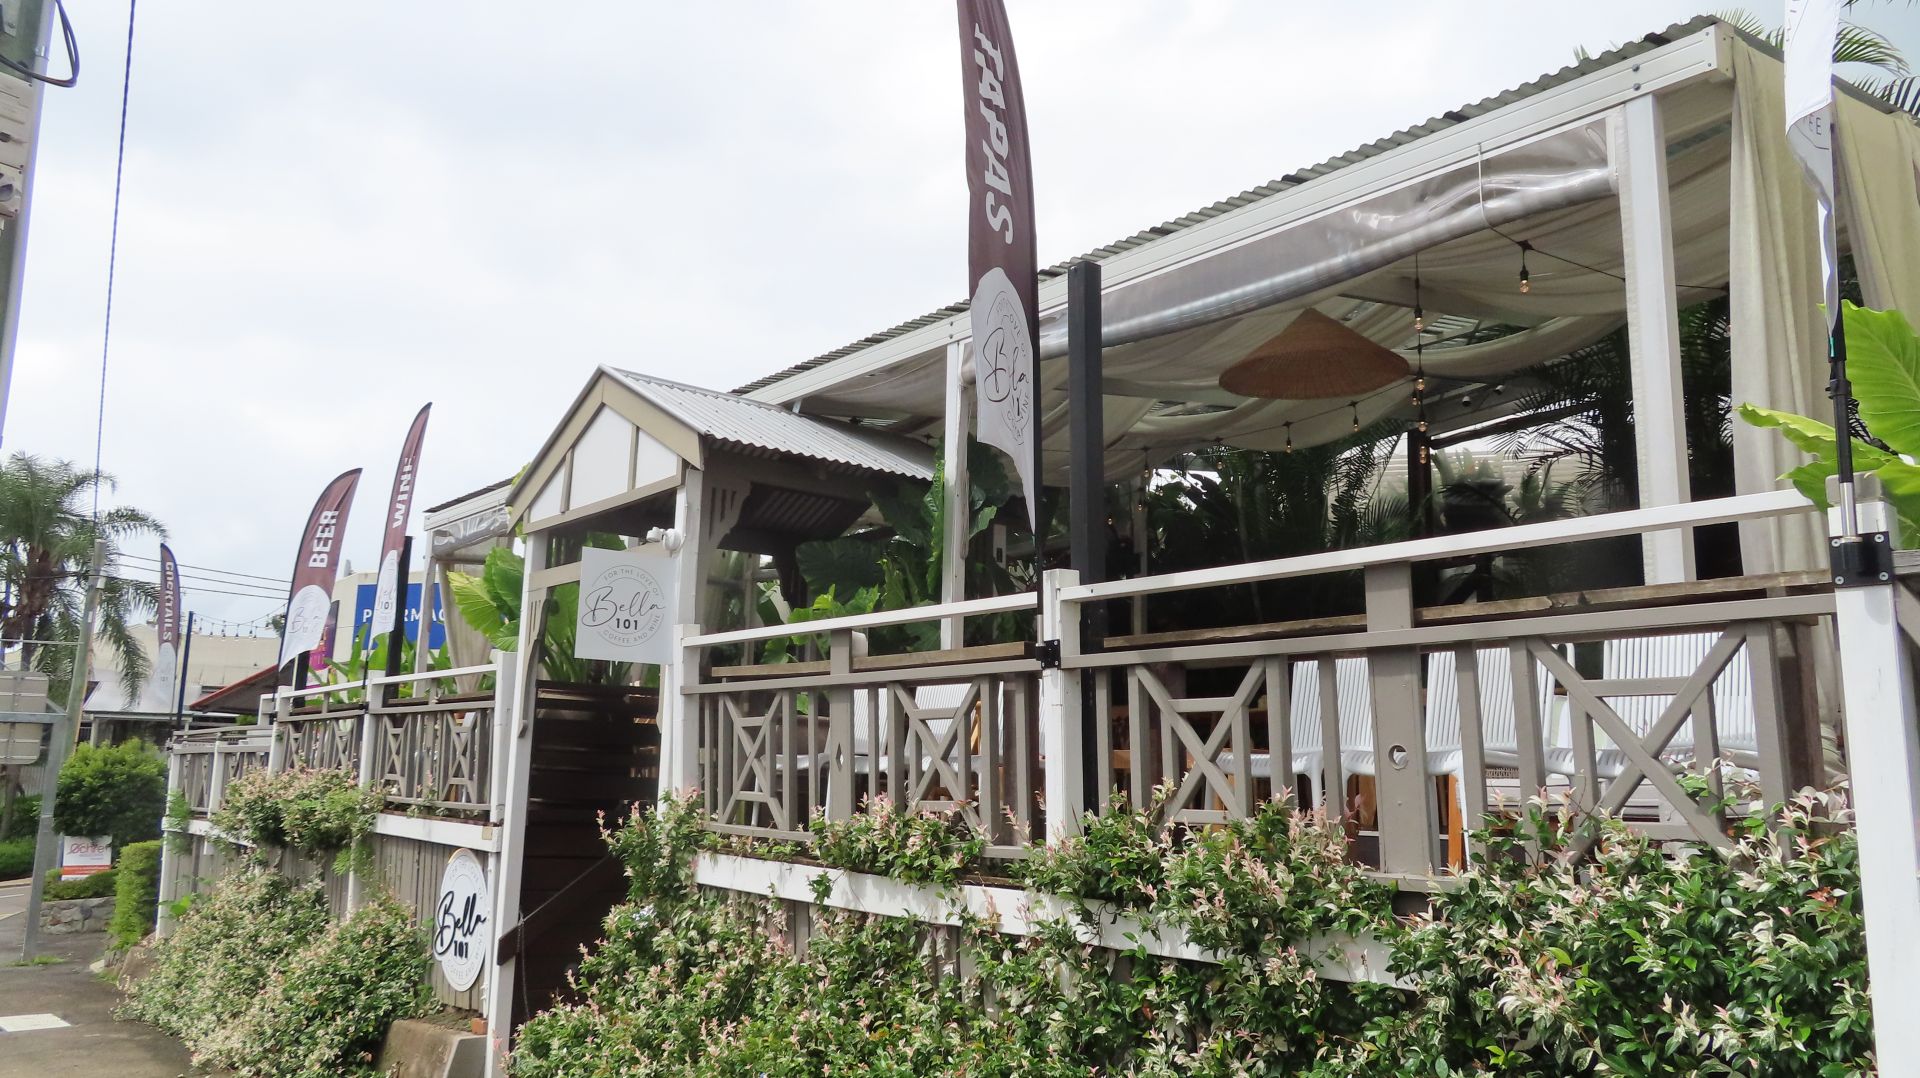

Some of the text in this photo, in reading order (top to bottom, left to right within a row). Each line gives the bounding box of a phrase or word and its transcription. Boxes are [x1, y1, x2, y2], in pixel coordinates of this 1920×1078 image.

[974, 22, 1014, 245] TAPAS
[308, 510, 340, 568] BEER
[604, 570, 618, 581] FOR
[637, 572, 652, 586] LOVE
[652, 587, 660, 597] OF
[582, 586, 666, 627] Bella
[616, 618, 638, 630] 101
[603, 614, 661, 643] COFFEE AND WINE
[434, 890, 487, 956] Bella
[453, 940, 469, 959] 101
